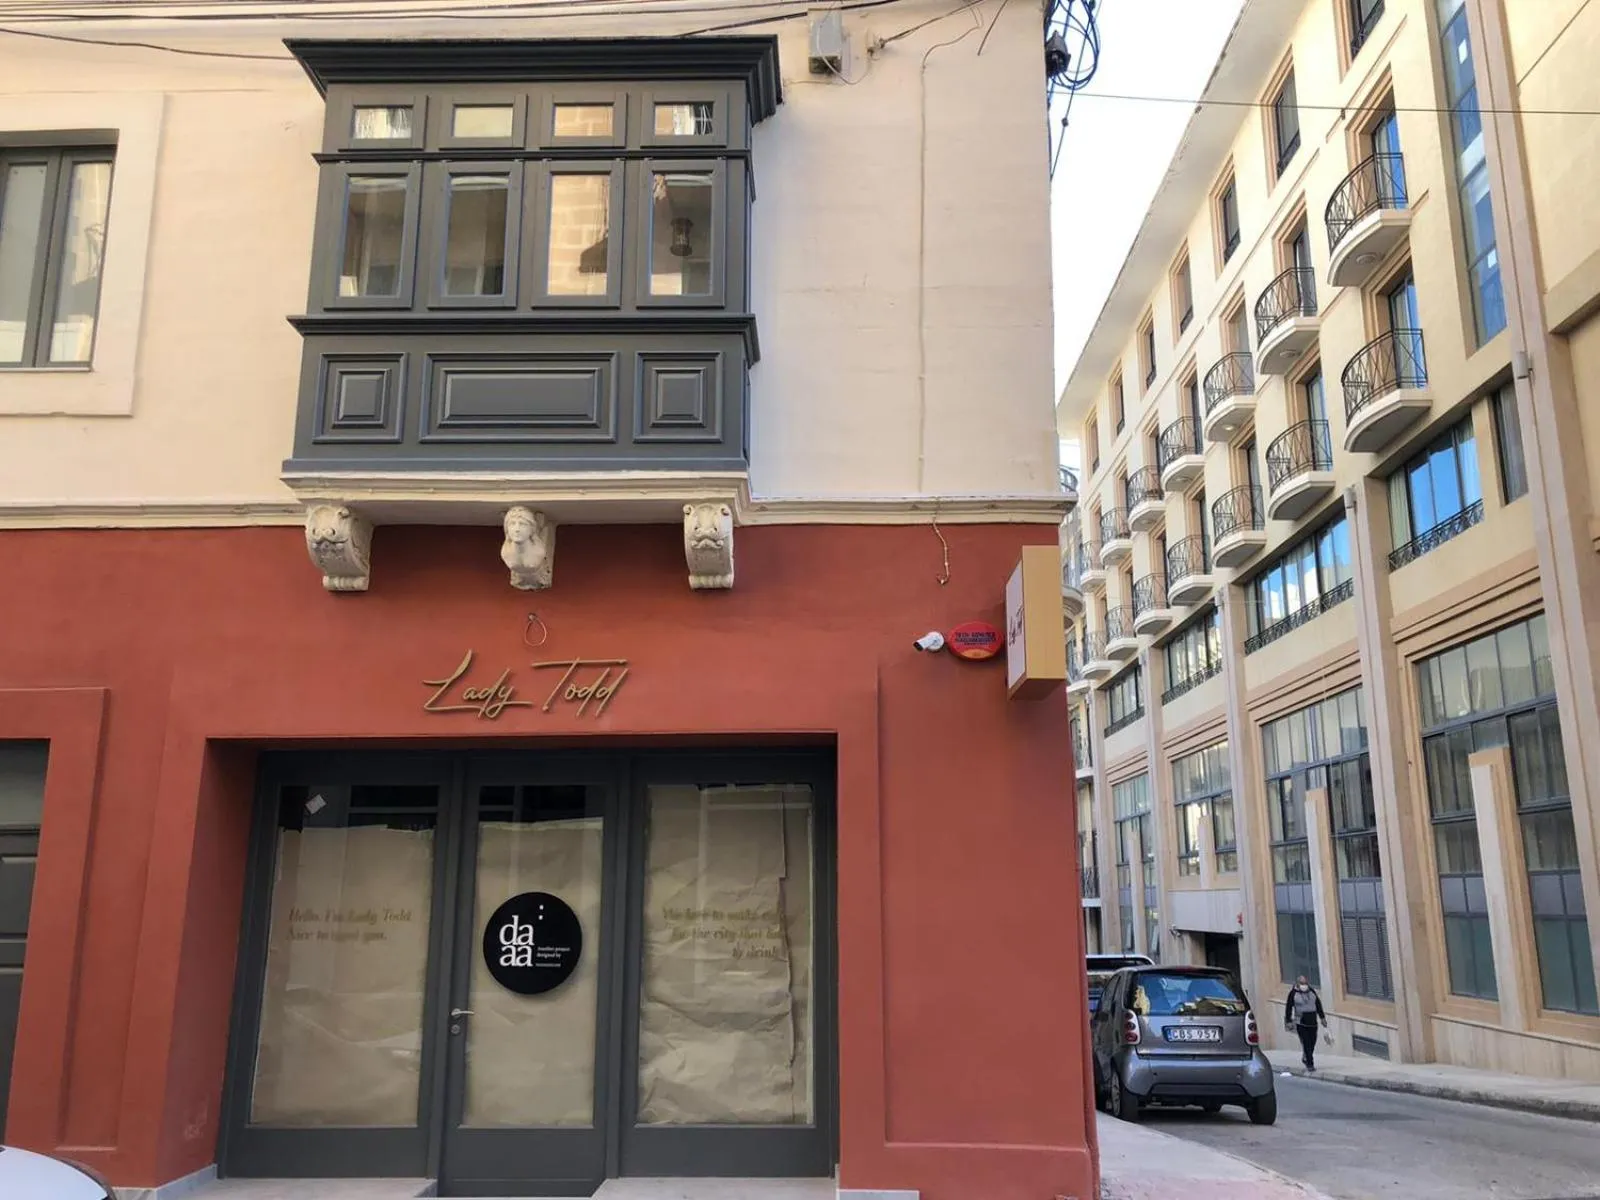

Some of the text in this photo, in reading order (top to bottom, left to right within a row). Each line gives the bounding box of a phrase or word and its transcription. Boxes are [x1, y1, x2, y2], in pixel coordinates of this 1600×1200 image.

[422, 648, 629, 719] Lady Todd
[383, 908, 412, 922] Todd
[1197, 1028, 1217, 1039] 957
